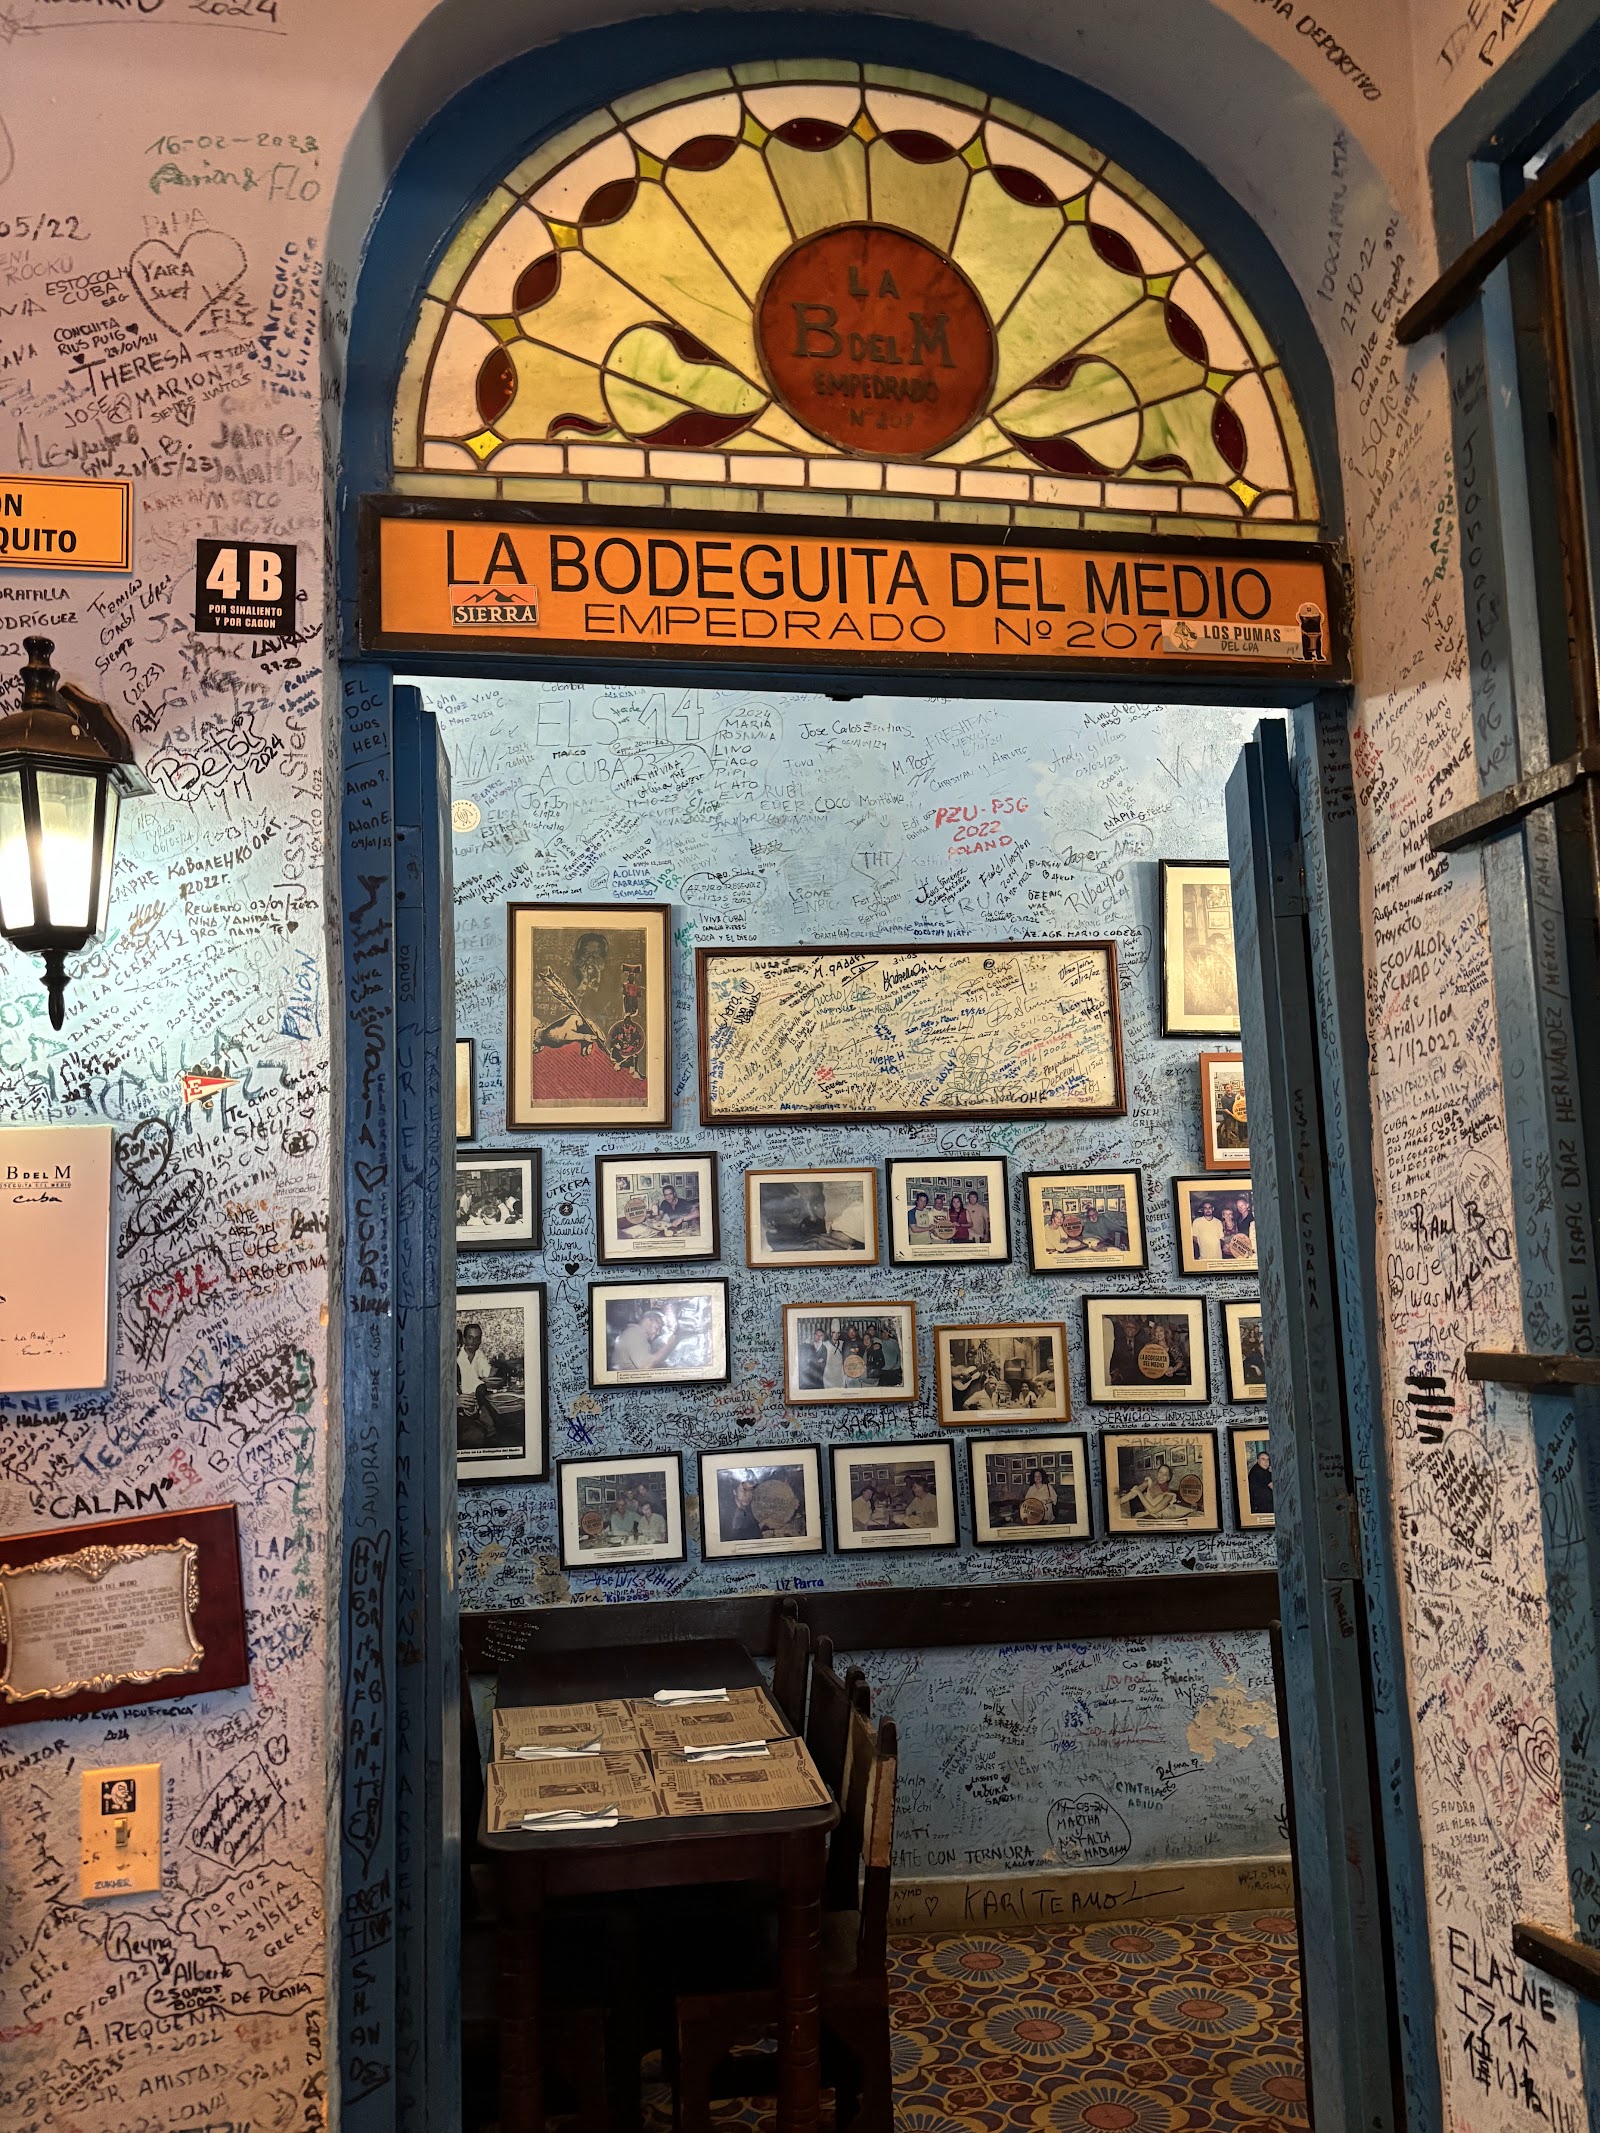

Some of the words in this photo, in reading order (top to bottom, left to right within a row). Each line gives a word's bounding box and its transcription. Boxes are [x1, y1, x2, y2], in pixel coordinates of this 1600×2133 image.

[62, 282, 120, 305] CUBA
[848, 265, 899, 299] LA
[53, 317, 121, 343] CONCHITA
[792, 303, 842, 358] B
[848, 332, 904, 364] DEL
[909, 312, 956, 368] M
[68, 341, 193, 397] THERESA
[135, 365, 223, 419] MARION
[814, 372, 940, 404] EMPEDRADO
[0, 493, 23, 517] N
[446, 529, 528, 587] LA
[550, 534, 929, 606] BODEGUITA
[951, 552, 1066, 613] DEL
[1086, 560, 1273, 620] MEDIO
[208, 604, 227, 614] POR
[230, 605, 283, 617] SINALIENTO
[215, 616, 221, 626] Y
[223, 617, 242, 627] POR
[453, 605, 537, 624] SIERRA
[584, 602, 947, 644] EMPEDRADO
[1066, 619, 1163, 651] 207
[1203, 625, 1229, 641] LOS
[1234, 626, 1282, 643] PUMAS
[1221, 640, 1240, 652] DEL
[345, 680, 369, 698] EL
[345, 694, 384, 720] DOC
[735, 707, 771, 719] 2024
[831, 719, 862, 735] Carlos
[713, 743, 752, 758] LINO
[566, 758, 629, 786] CUBA
[346, 776, 378, 796] Alma
[953, 820, 1002, 843] 2022
[1382, 1115, 1408, 1135] CUBA
[6, 1166, 19, 1180] B
[23, 1172, 49, 1180] DEL
[54, 1165, 72, 1180] M
[546, 1176, 592, 1199] UTRERA
[926, 1850, 957, 1867] CON
[963, 1847, 1035, 1865] TERNURA
[1446, 1925, 1557, 2025] ELAINE
